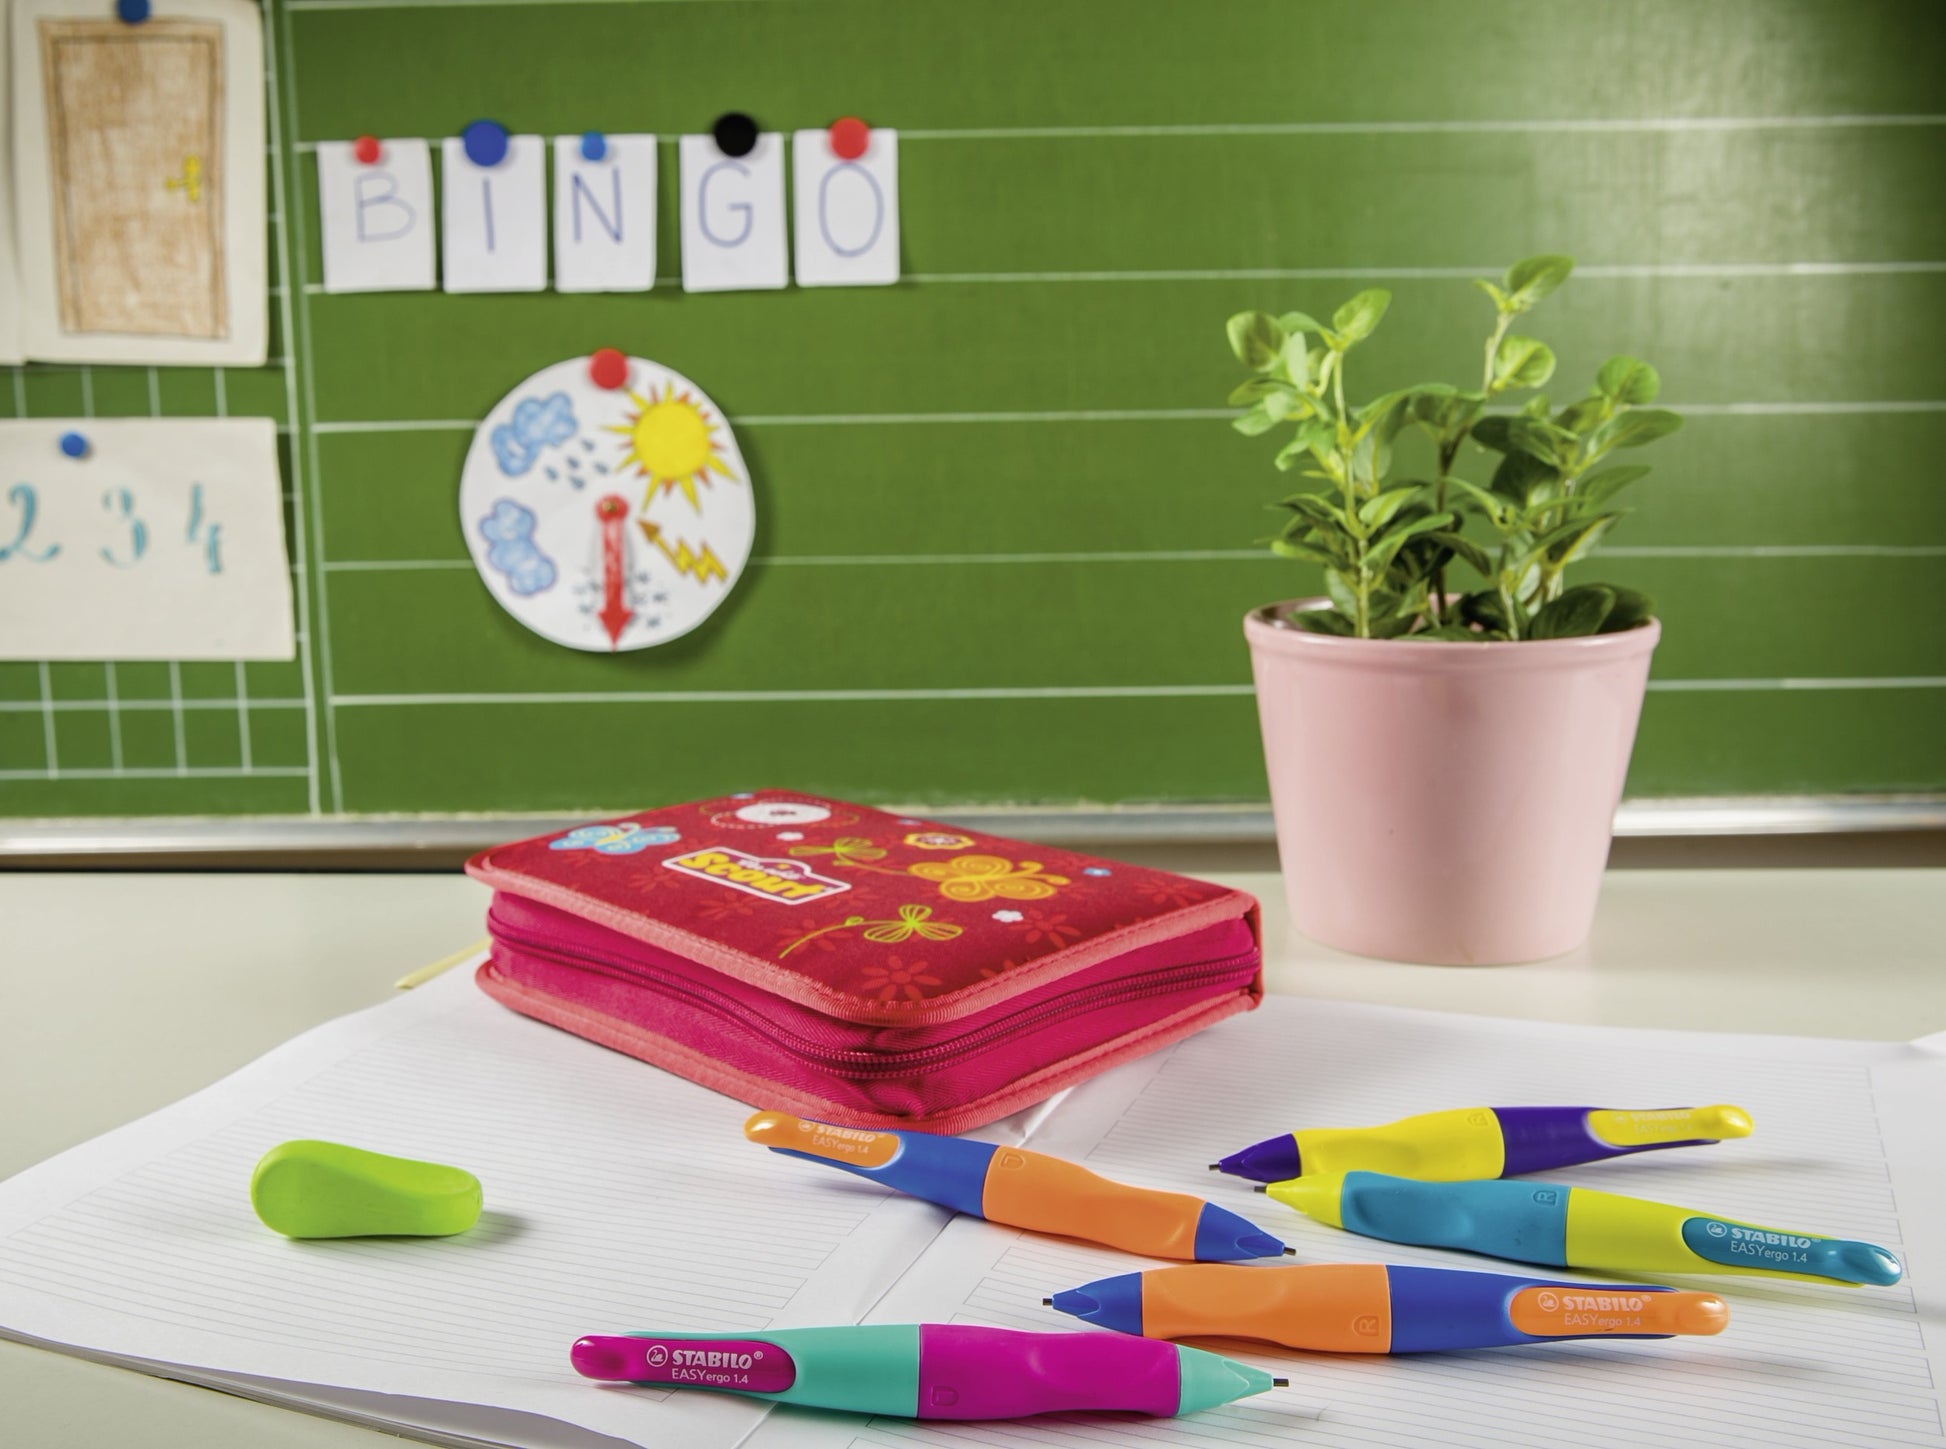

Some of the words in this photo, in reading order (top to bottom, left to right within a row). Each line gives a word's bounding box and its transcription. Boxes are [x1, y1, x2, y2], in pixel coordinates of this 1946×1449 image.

[0, 482, 61, 563] 2
[101, 486, 148, 569] 3
[679, 852, 827, 898] Scout
[1730, 1240, 1789, 1262] EASYergo
[1792, 1252, 1808, 1264] 1.4
[1626, 1317, 1642, 1327] 1.4
[672, 1368, 731, 1384] EASYergo
[734, 1374, 749, 1384] 1.4
